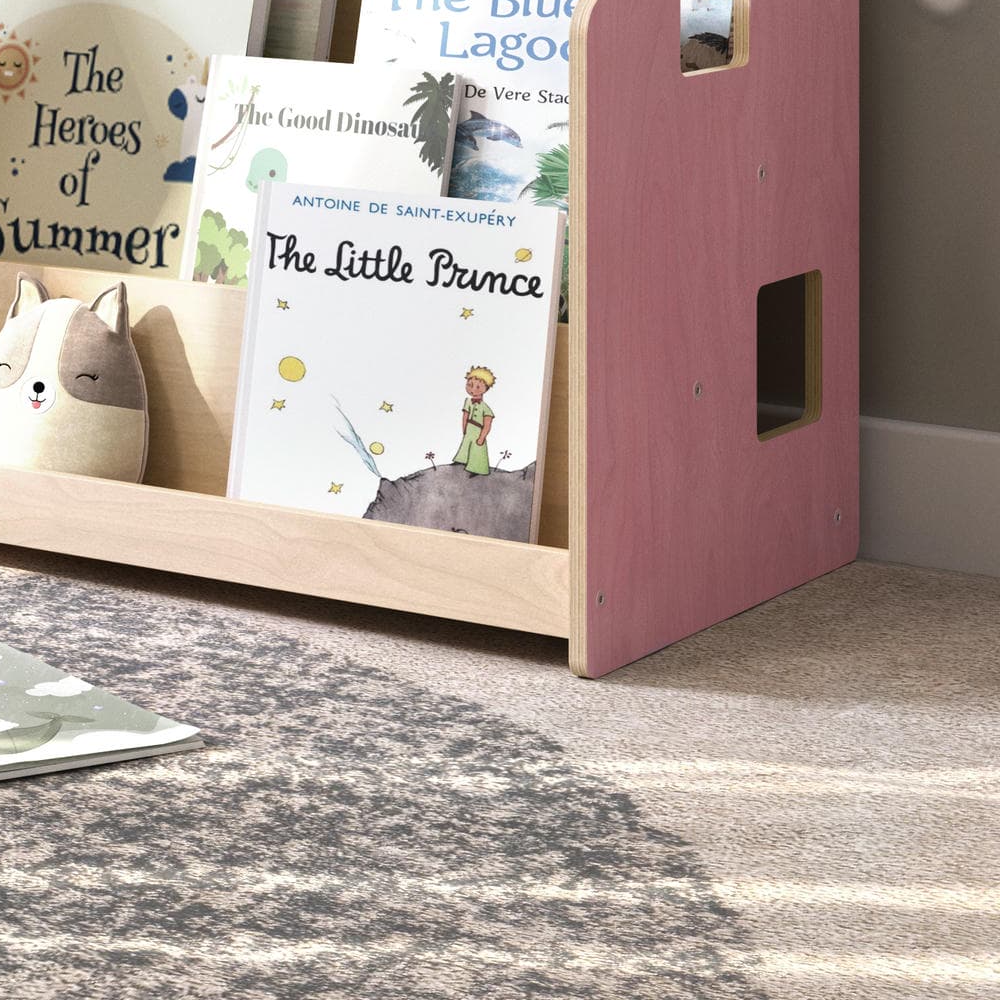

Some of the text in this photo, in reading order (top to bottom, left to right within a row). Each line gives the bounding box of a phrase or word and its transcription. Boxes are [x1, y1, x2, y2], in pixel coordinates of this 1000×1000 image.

[63, 44, 124, 96] The
[464, 84, 486, 99] De
[493, 86, 531, 102] Vere
[28, 100, 142, 155] Heroes
[234, 103, 273, 126] The
[278, 106, 332, 131] Good
[59, 149, 101, 208] of
[292, 194, 517, 228] ANTOINE DE SAINT-EXUPÉRY
[266, 231, 545, 300] The Little Prince
